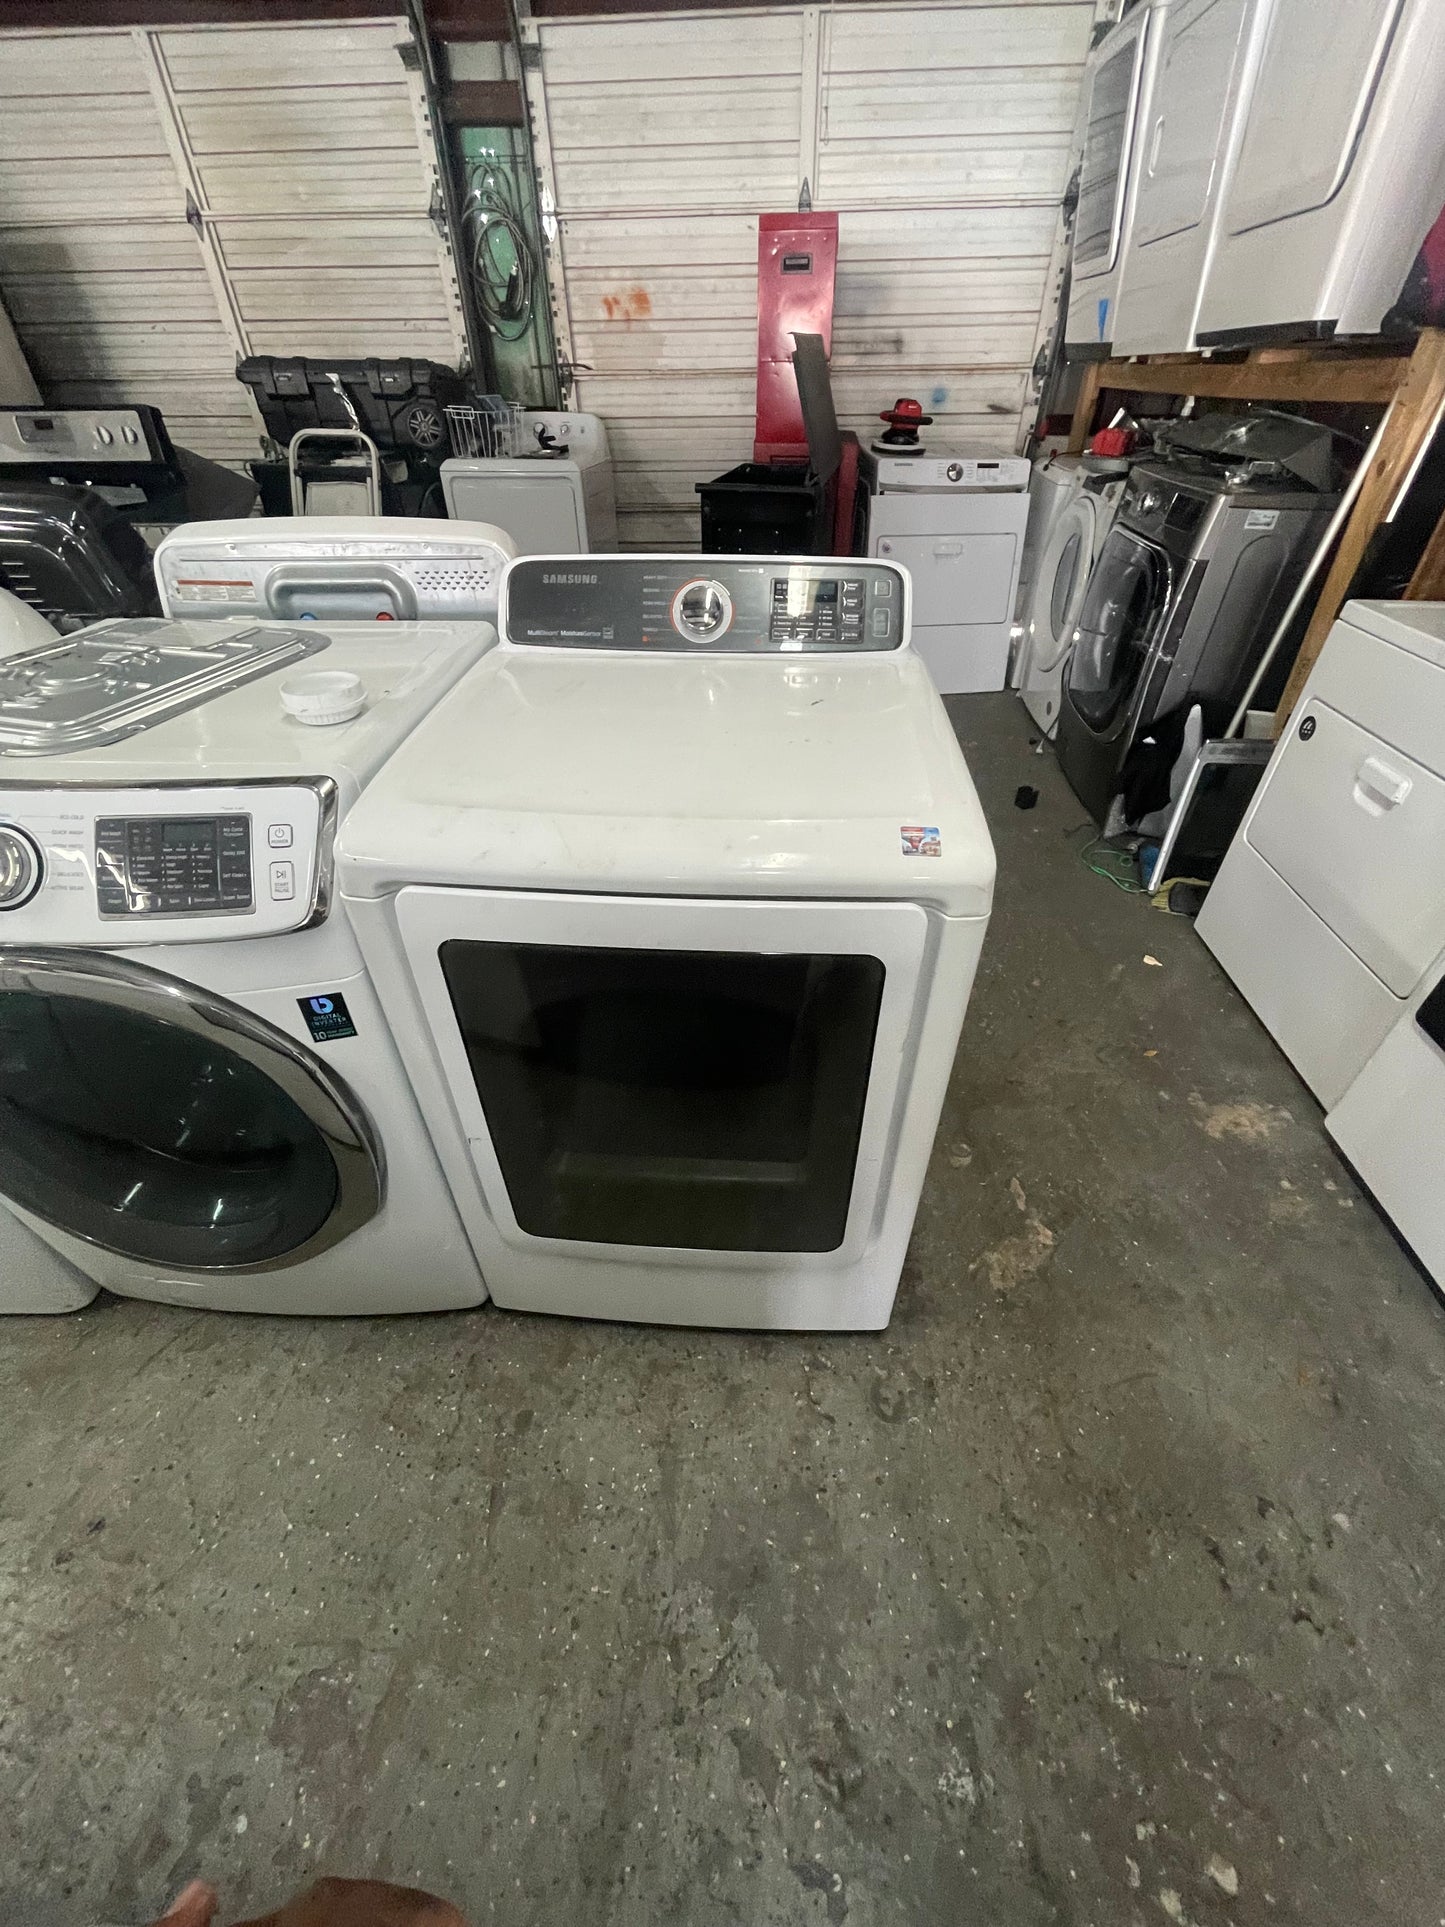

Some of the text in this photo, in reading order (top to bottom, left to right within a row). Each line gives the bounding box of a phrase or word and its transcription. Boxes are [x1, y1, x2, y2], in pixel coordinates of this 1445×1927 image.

[543, 574, 598, 584] SAMSUNG
[313, 1012, 342, 1021] DIGITAL
[313, 1031, 327, 1041] 10
